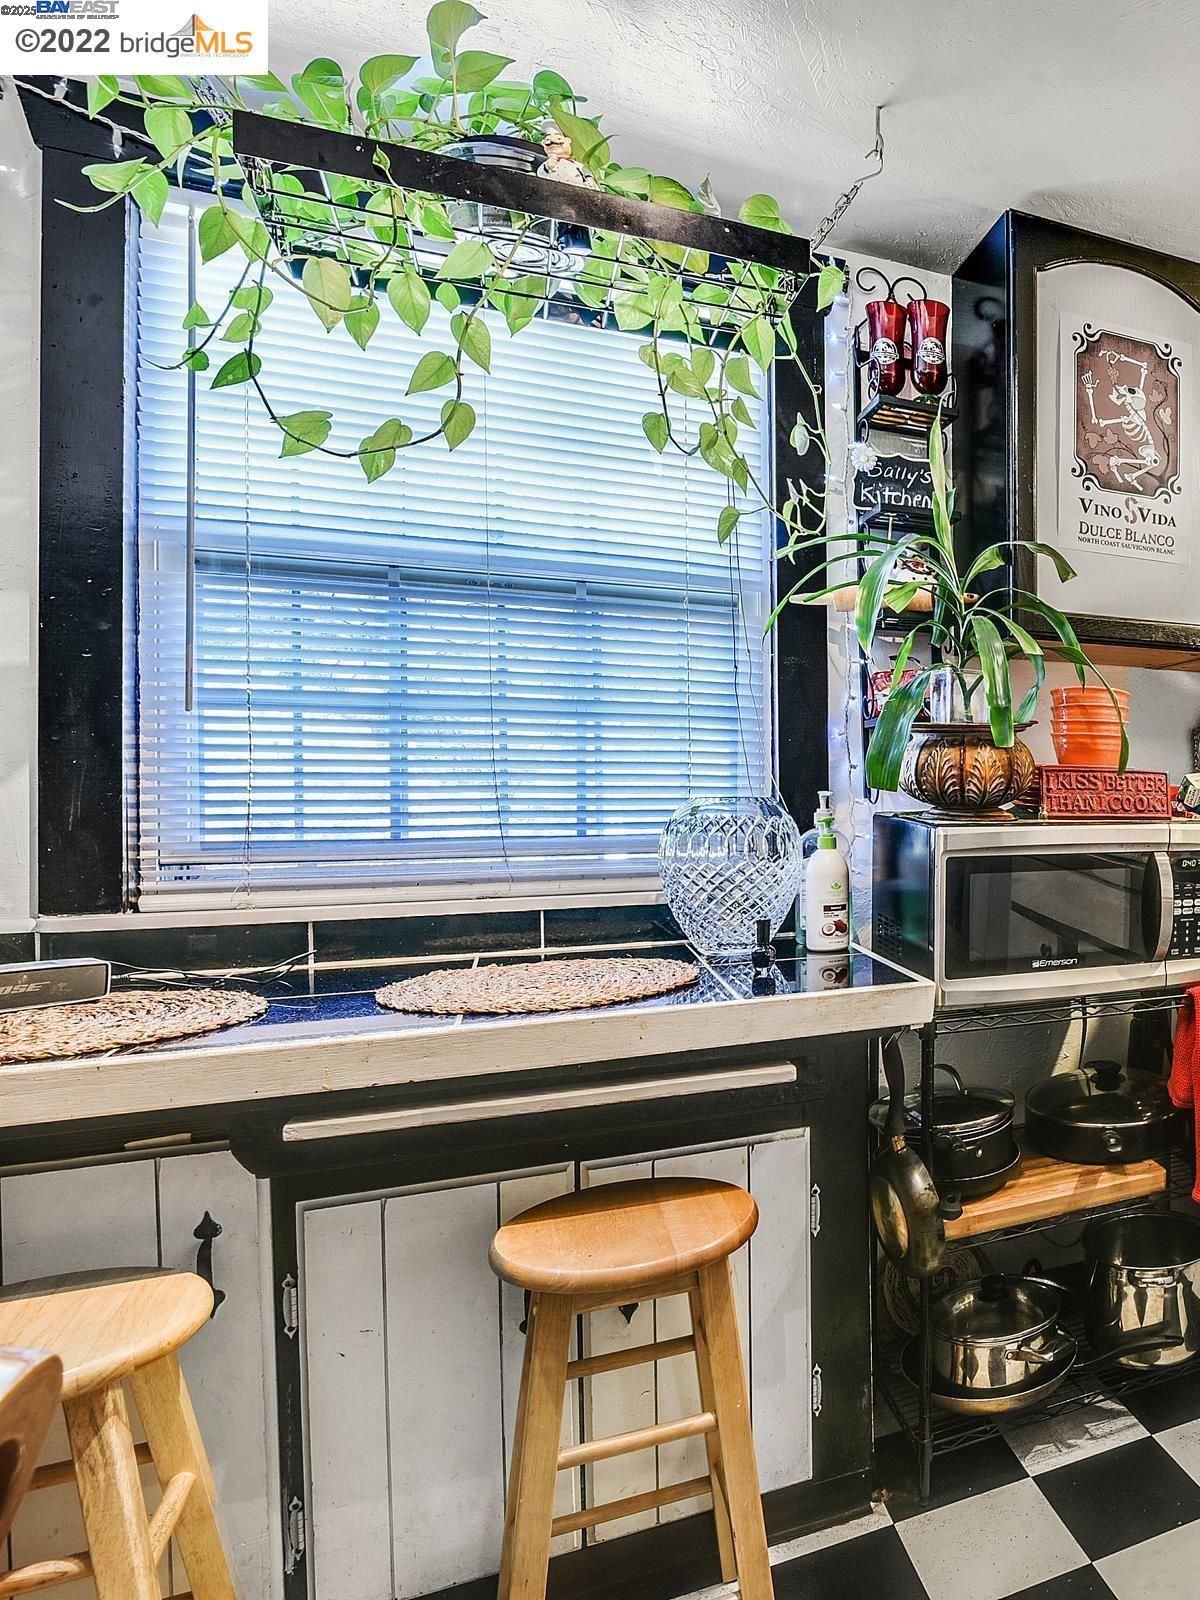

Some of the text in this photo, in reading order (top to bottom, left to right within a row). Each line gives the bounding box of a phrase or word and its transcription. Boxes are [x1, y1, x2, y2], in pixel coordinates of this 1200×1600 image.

[861, 482, 933, 509] Kitchen
[1079, 521, 1175, 548] DULCE BLANCO
[1077, 536, 1175, 556] NORTH COAST SAUVIGNON BLANC
[1046, 772, 1167, 793] I KISS BETTER
[1047, 794, 1096, 812] THAN
[1039, 958, 1078, 967] Emerson
